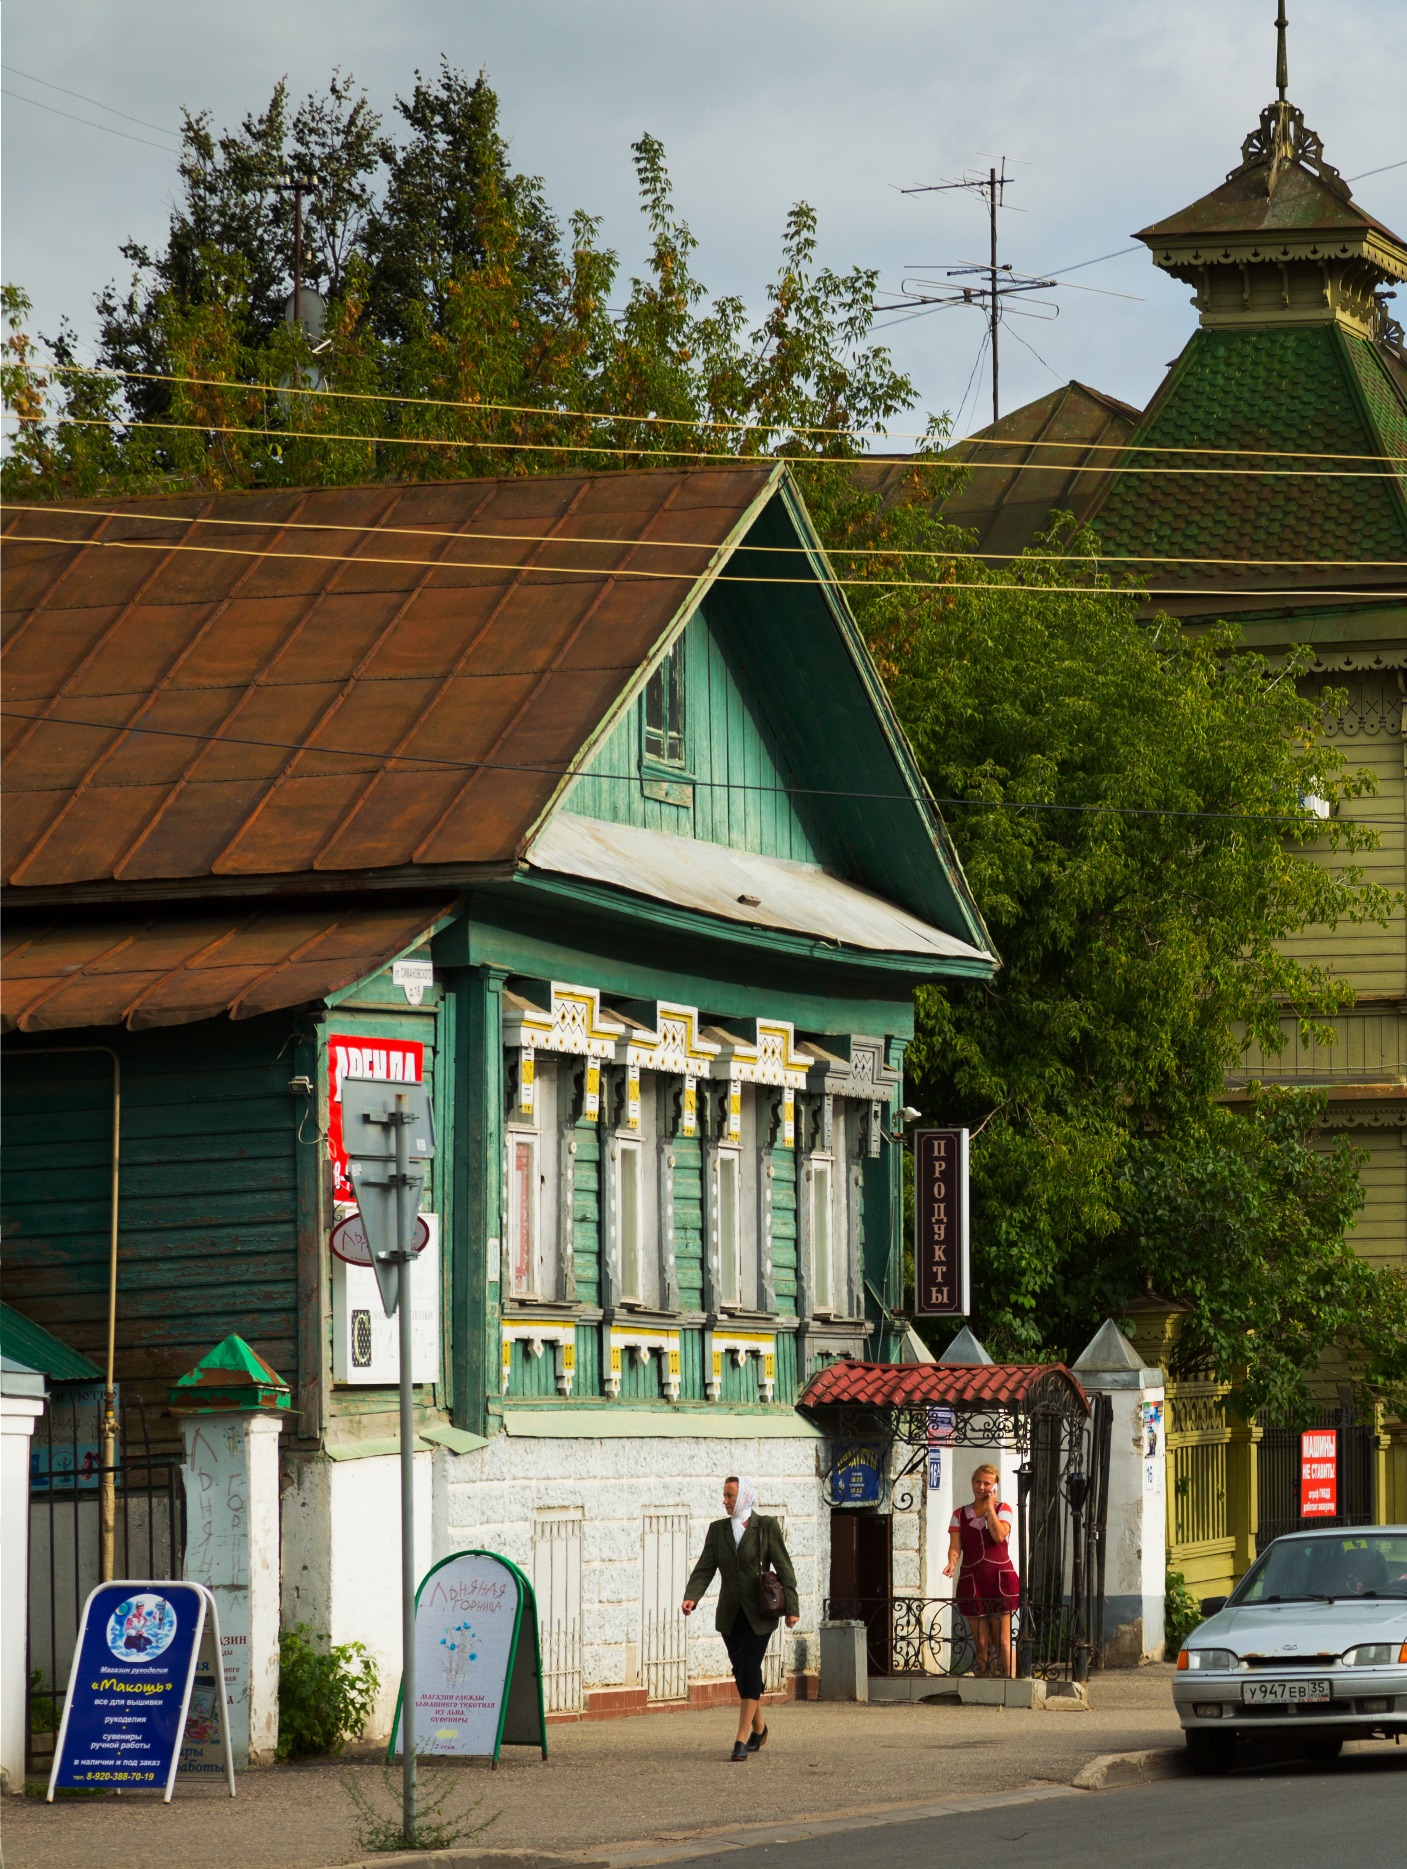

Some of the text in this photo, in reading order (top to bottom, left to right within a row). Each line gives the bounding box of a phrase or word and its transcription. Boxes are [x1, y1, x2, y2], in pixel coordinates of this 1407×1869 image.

[930, 1140, 949, 1304] ПРОДУКТЫ
[1303, 1435, 1335, 1458] МАШИНЫ
[1302, 1463, 1311, 1479] НЕ
[430, 1580, 507, 1607] ЛЬНЯНАЯ
[452, 1598, 503, 1613] ГОРНИЦА
[131, 1667, 168, 1675] рукоделия
[1249, 1682, 1325, 1699] У947ЕВ 35
[454, 1694, 485, 1702] ОДЕЖДЫ
[104, 1716, 147, 1724] рукоделия
[102, 1733, 142, 1741] сувениры
[90, 1741, 151, 1750] ручной работы
[86, 1772, 155, 1781] 8-920-388-70-19
